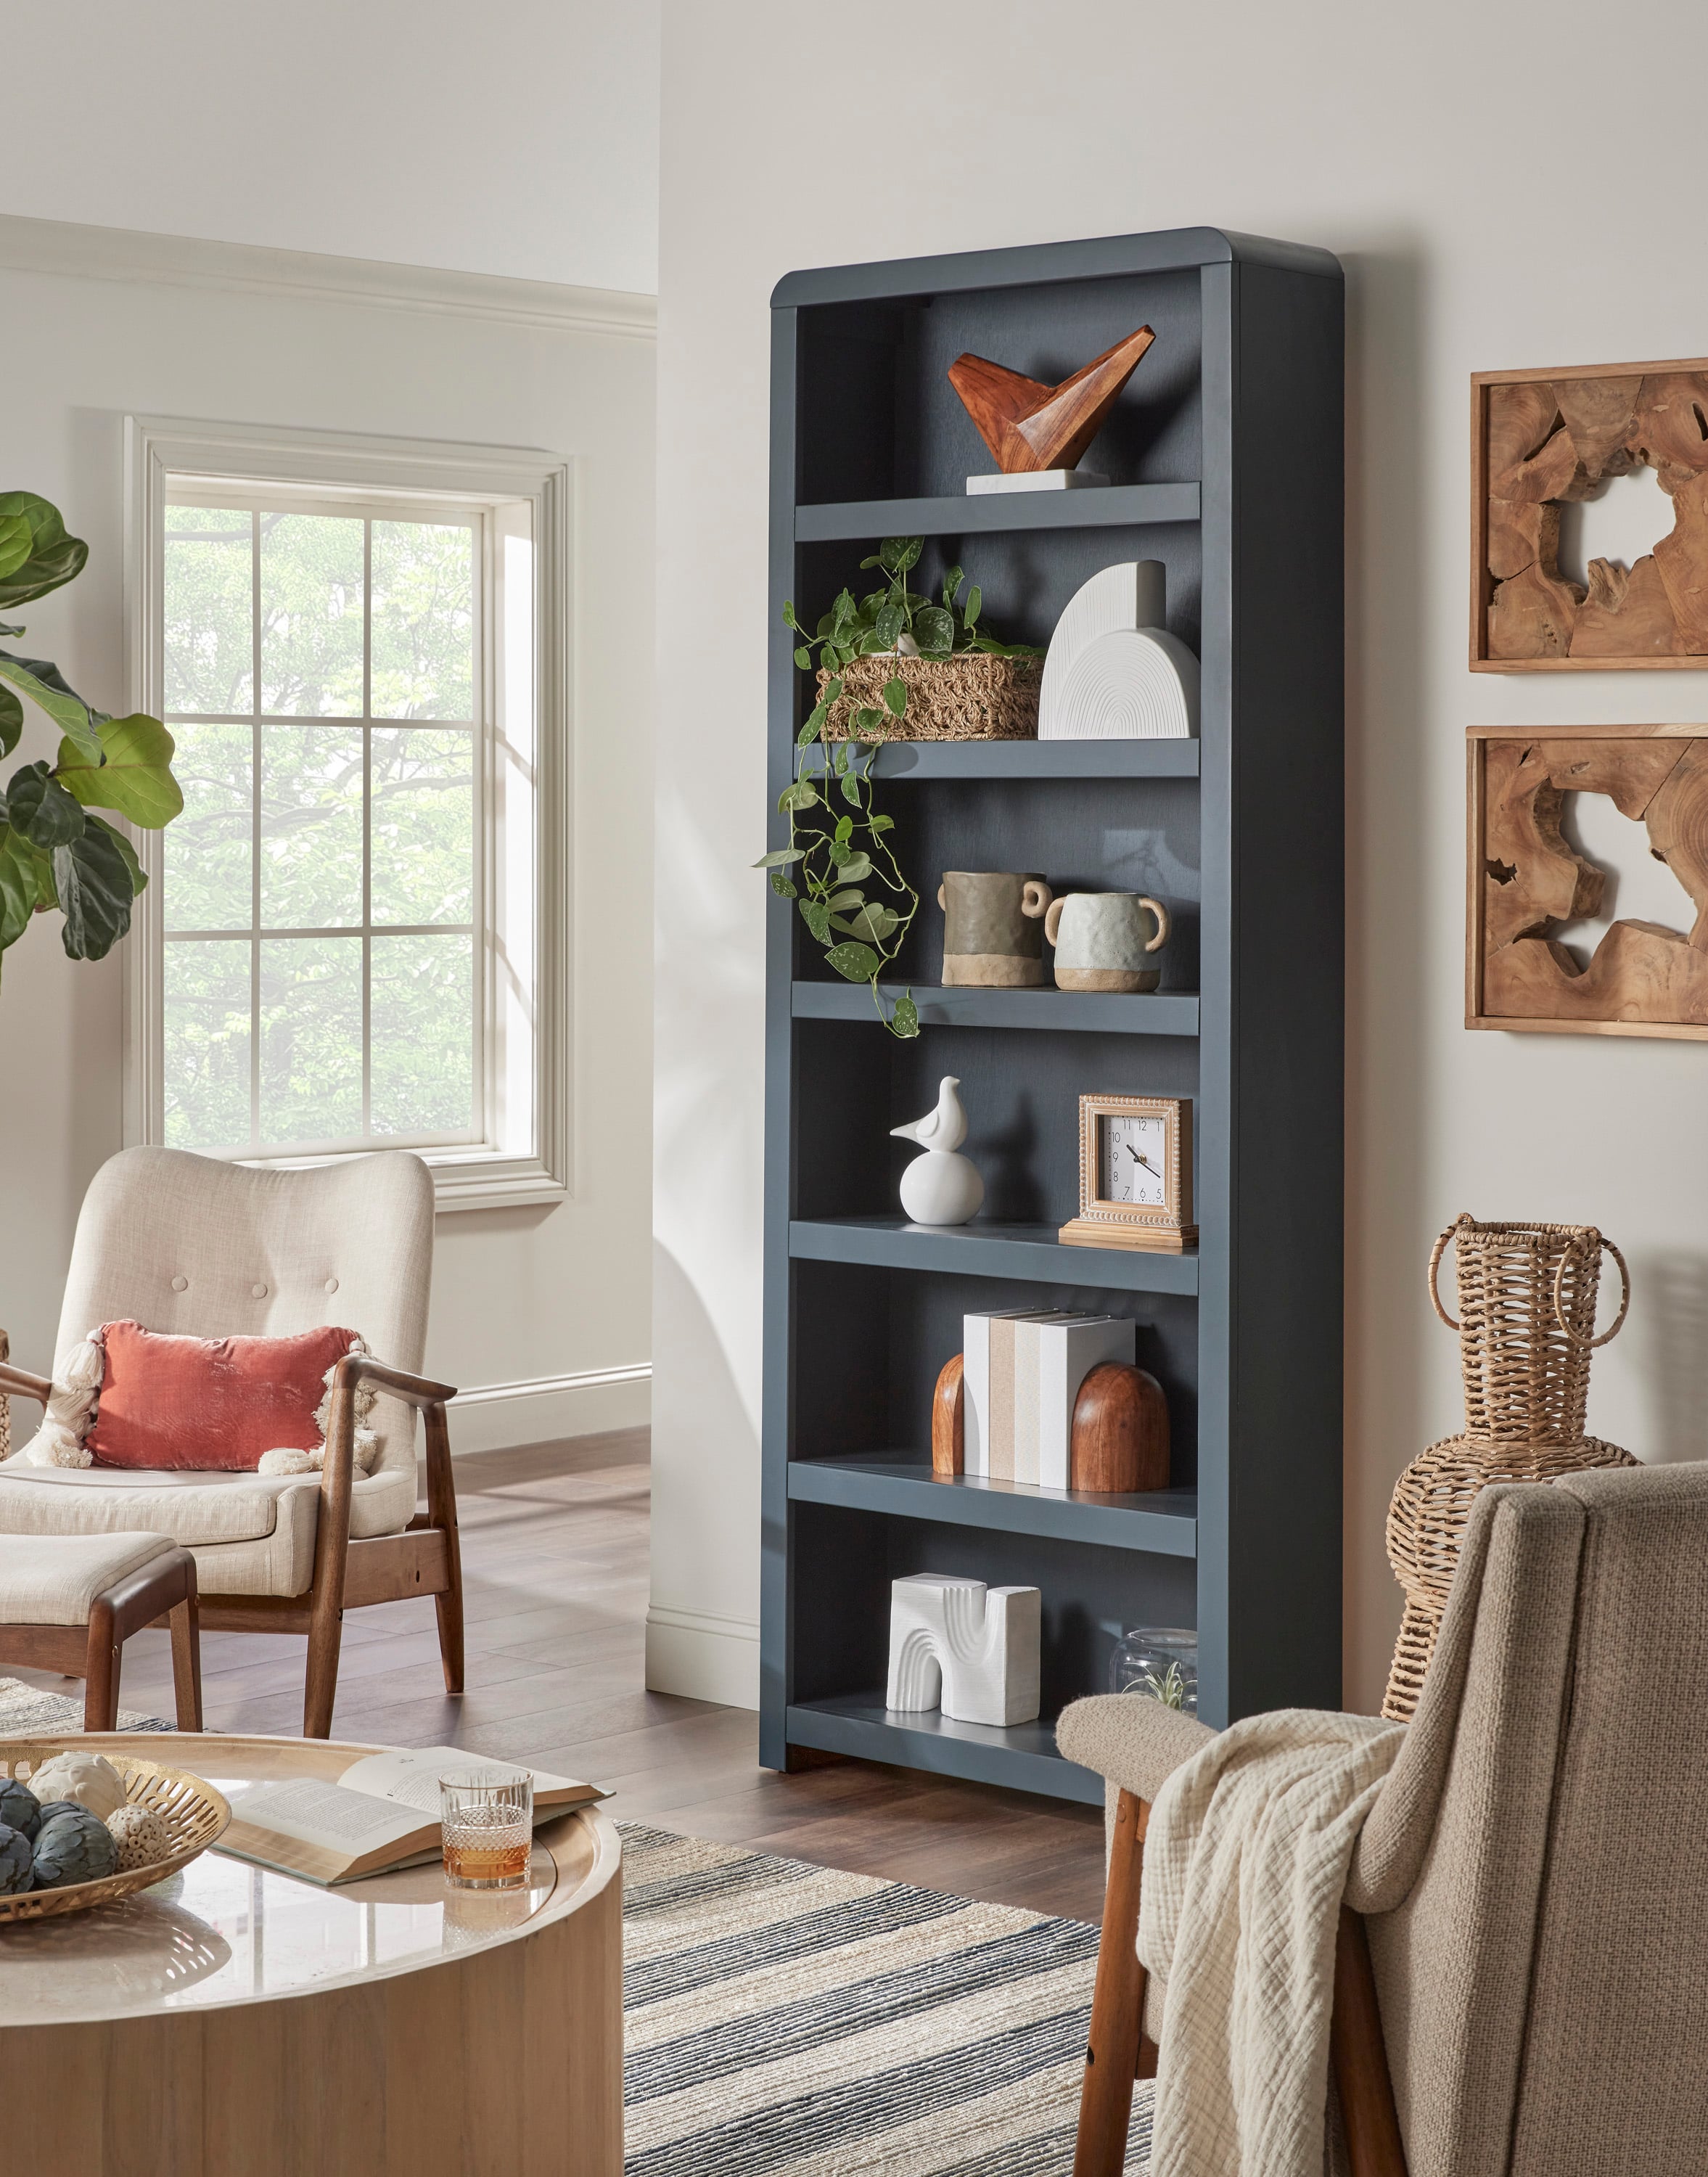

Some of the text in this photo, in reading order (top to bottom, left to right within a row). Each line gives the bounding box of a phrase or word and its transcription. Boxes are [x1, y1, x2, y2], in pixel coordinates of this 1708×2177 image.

[1123, 1120, 1130, 1130] 11
[1138, 1120, 1146, 1131] 12
[1157, 1121, 1159, 1132] 1
[1112, 1132, 1120, 1143] 10
[1113, 1152, 1118, 1162] 9
[1113, 1171, 1118, 1182] 8
[1125, 1186, 1130, 1197] 7
[1140, 1188, 1146, 1198] 6
[1157, 1189, 1161, 1199] 5
